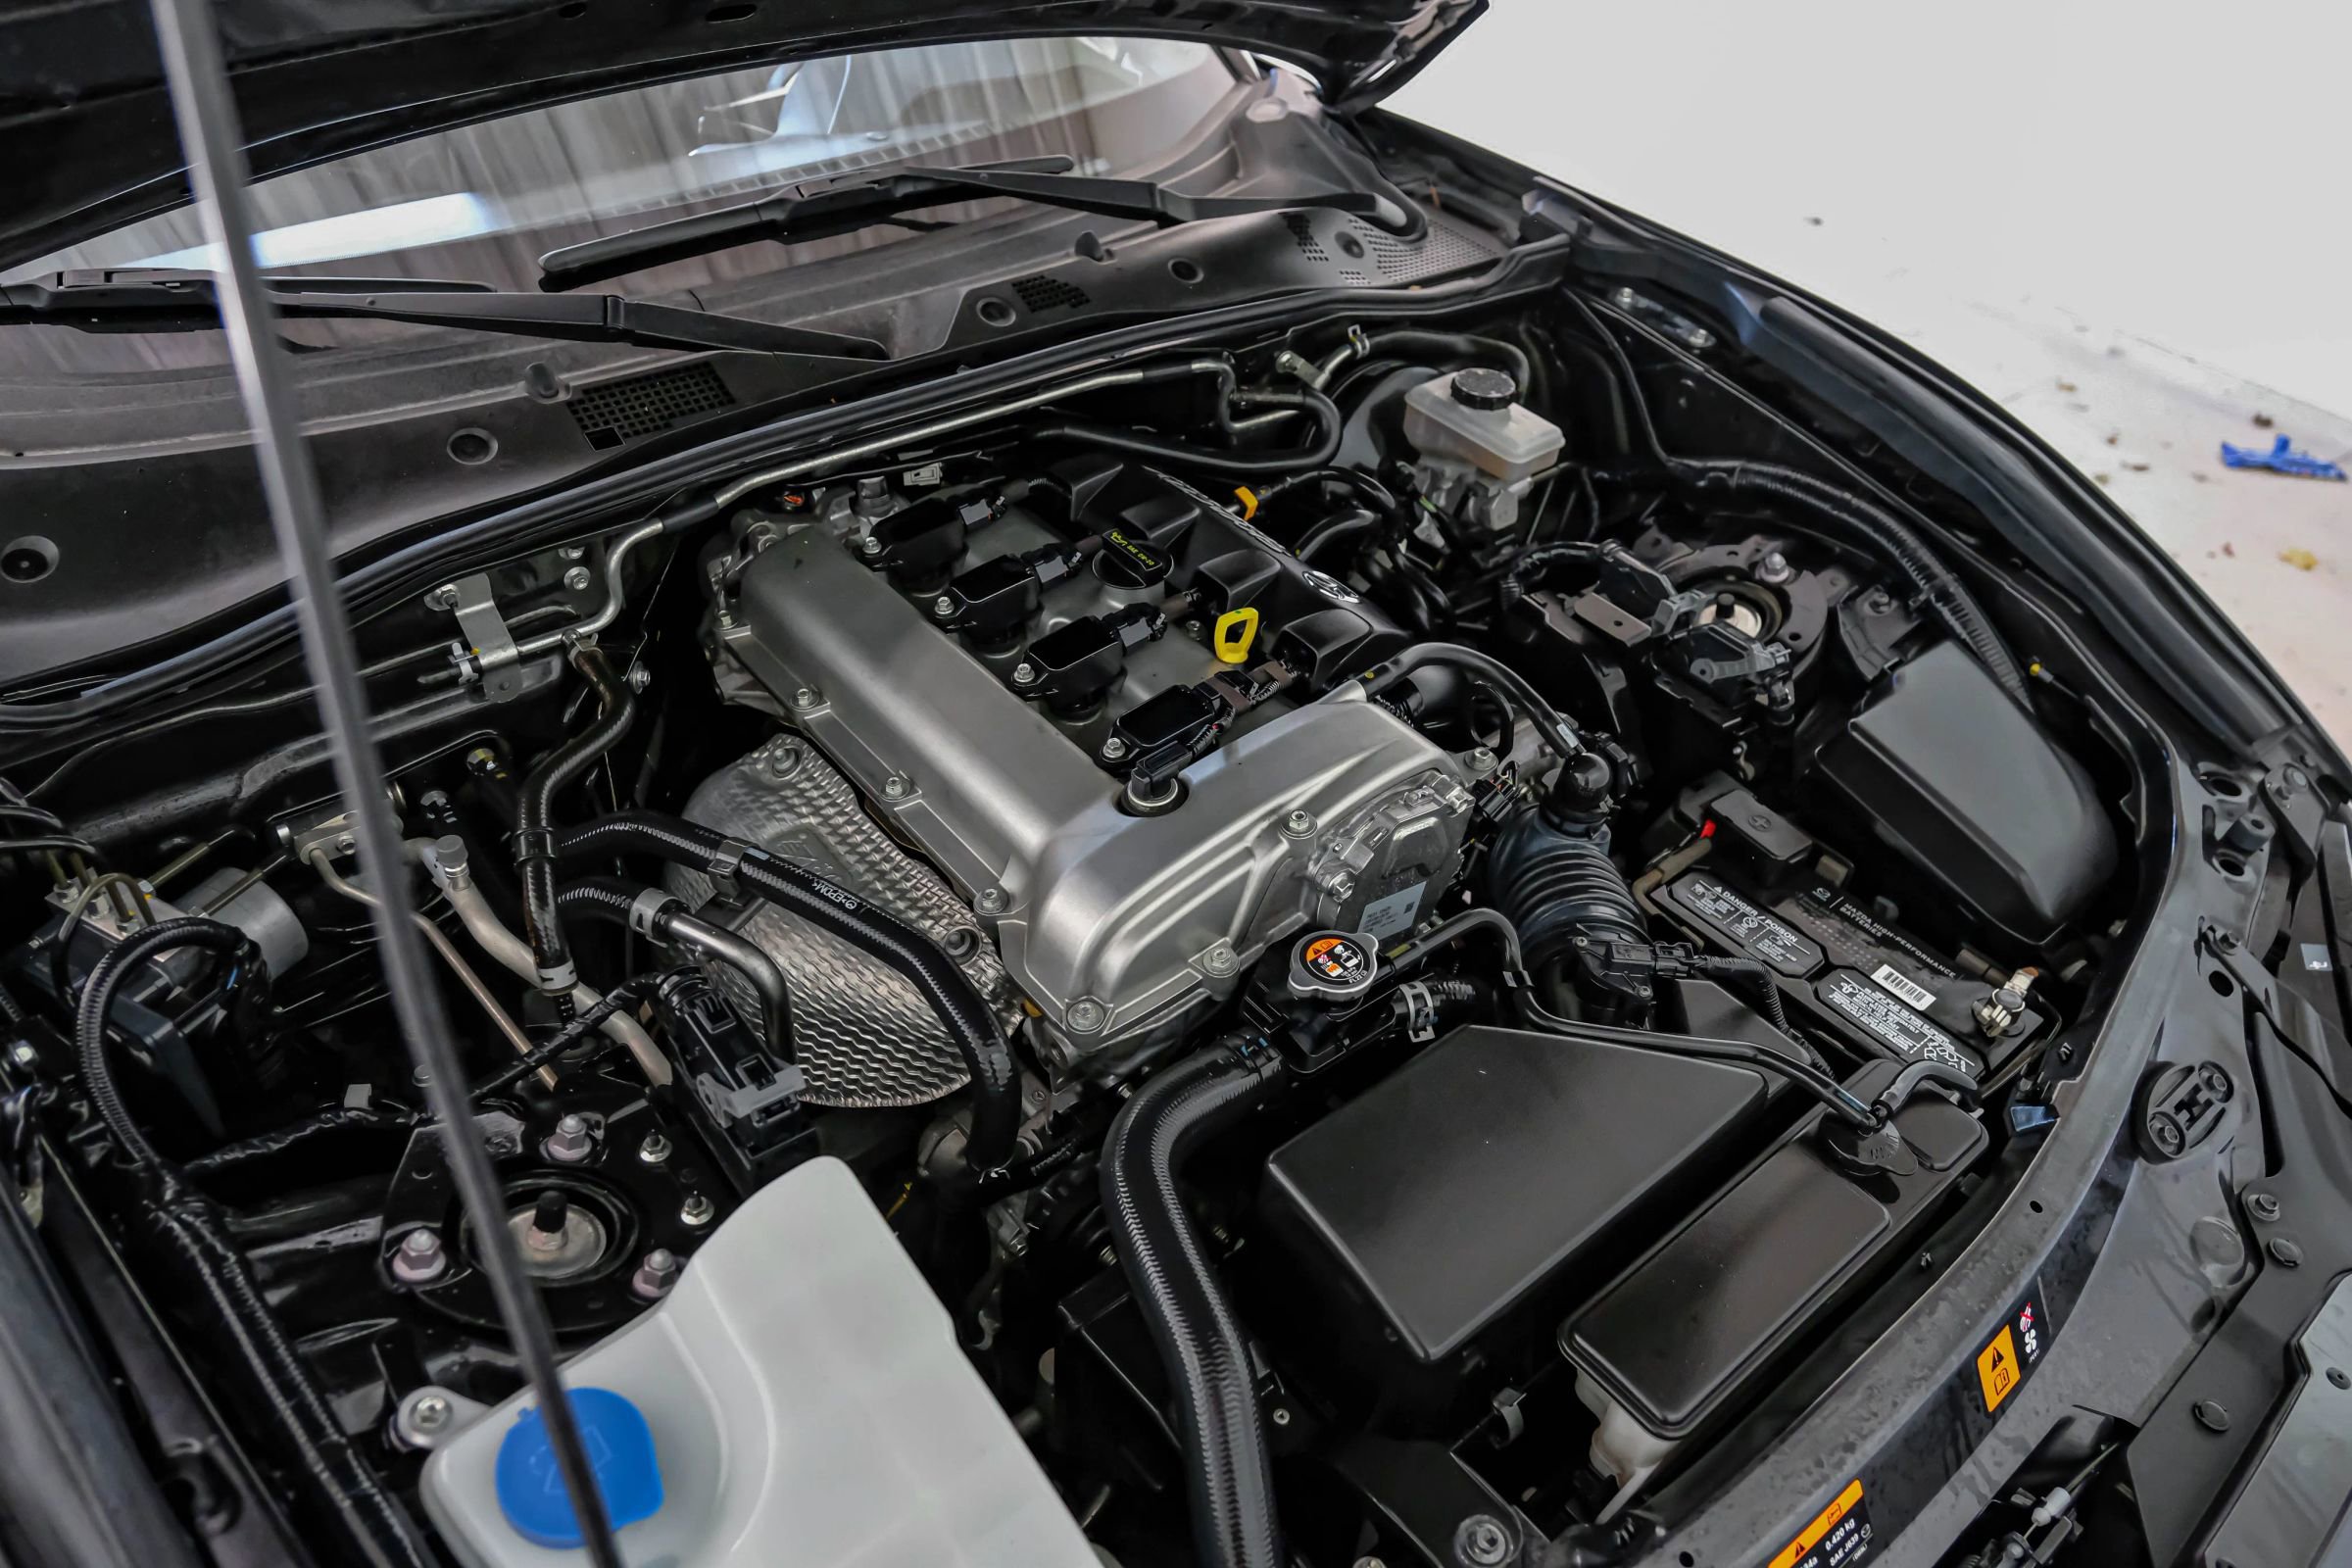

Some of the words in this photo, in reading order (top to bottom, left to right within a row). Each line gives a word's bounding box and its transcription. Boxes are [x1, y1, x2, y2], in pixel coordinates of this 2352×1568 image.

[1722, 890, 1759, 917] DANGER
[1764, 918, 1798, 944] POISON
[1839, 906, 1883, 938] BATTERIES
[1843, 903, 1872, 924] MAZDA
[1825, 1527, 1844, 1550] 0.420
[1843, 1518, 1855, 1532] kg
[1829, 1547, 1844, 1566] SAE
[1844, 1533, 1859, 1552] J639
